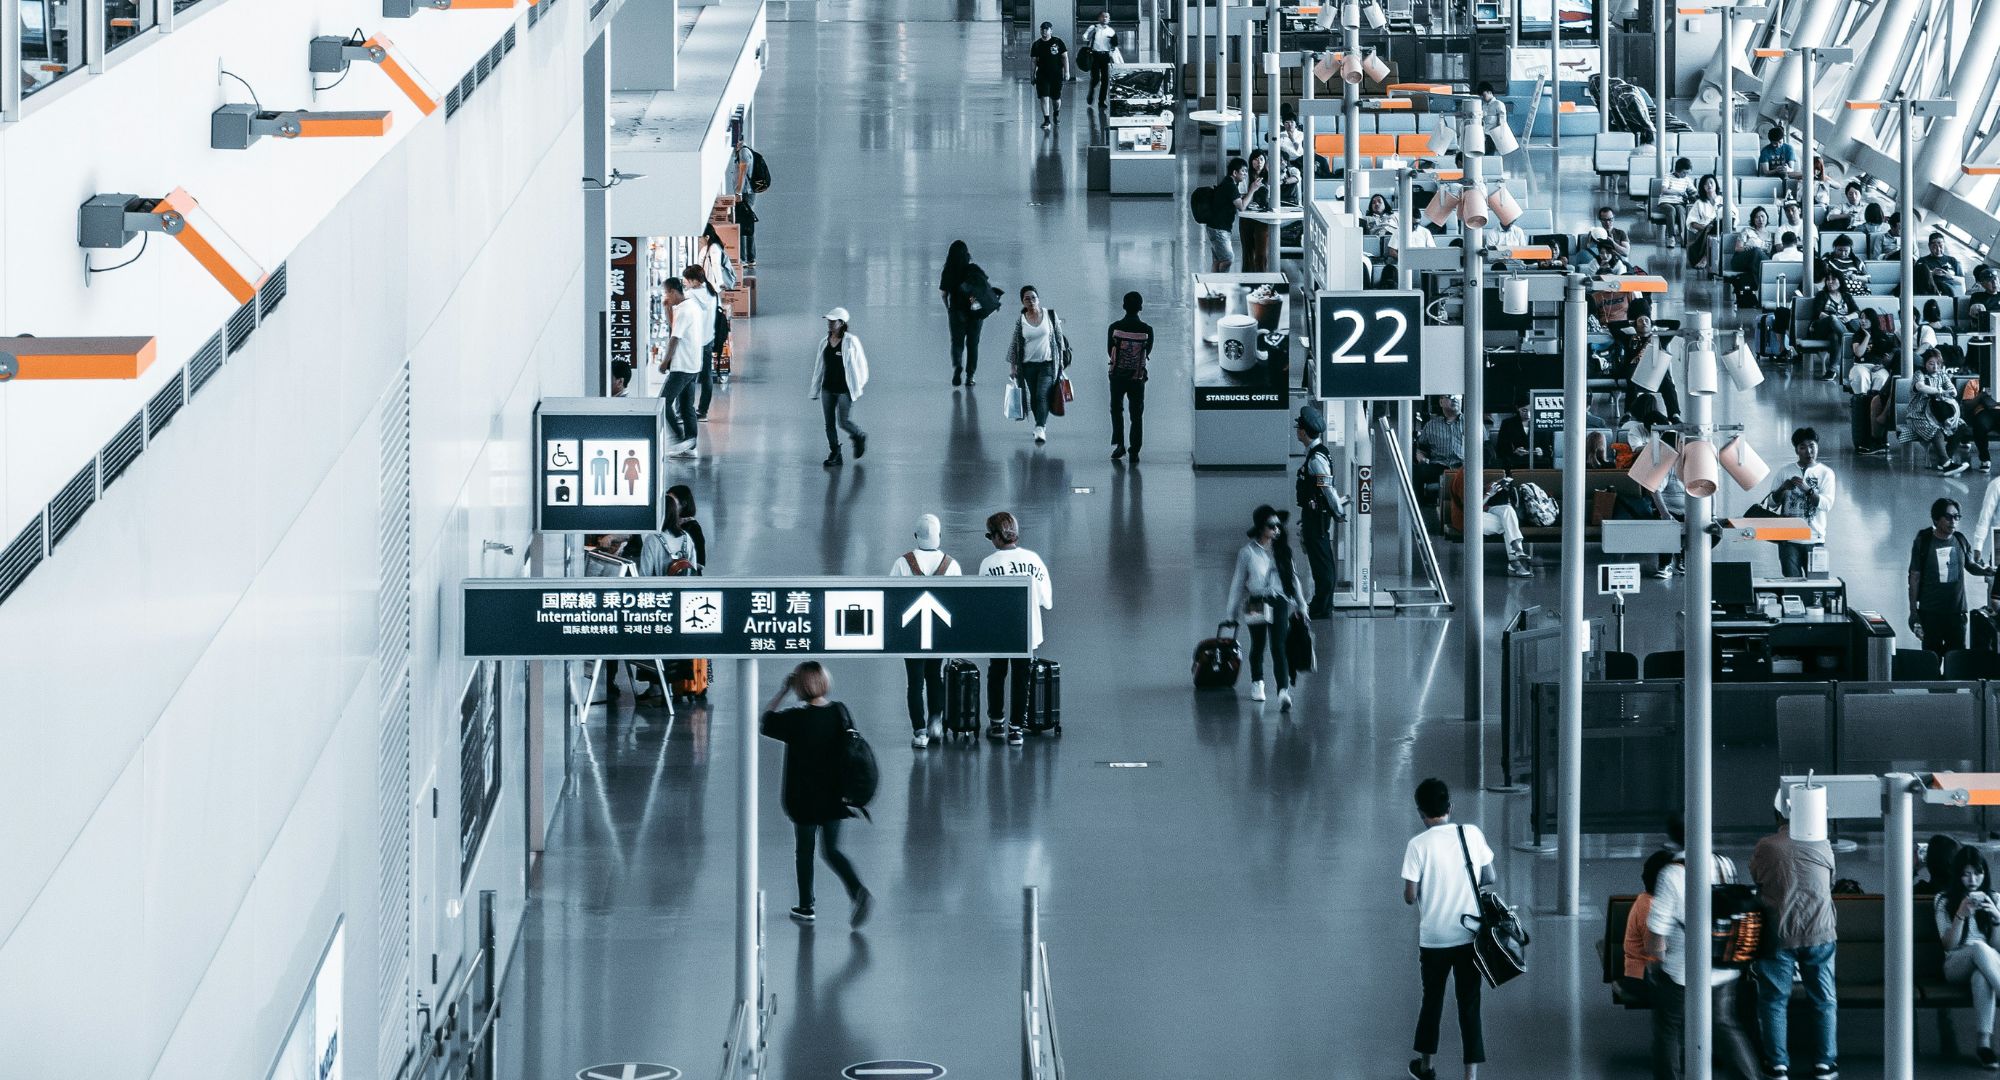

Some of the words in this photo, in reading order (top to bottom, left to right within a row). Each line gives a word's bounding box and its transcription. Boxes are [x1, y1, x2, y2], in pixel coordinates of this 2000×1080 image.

[1332, 308, 1409, 363] 22
[1206, 394, 1250, 402] STARBUCKS
[1361, 482, 1370, 512] AED
[542, 592, 597, 609] 国際線
[602, 592, 673, 609] 乗り継ぎ
[536, 610, 618, 622] International
[621, 610, 674, 622] Transfer
[743, 617, 812, 633] Arrivals
[750, 638, 776, 650] 到达
[784, 638, 811, 650] 도착
